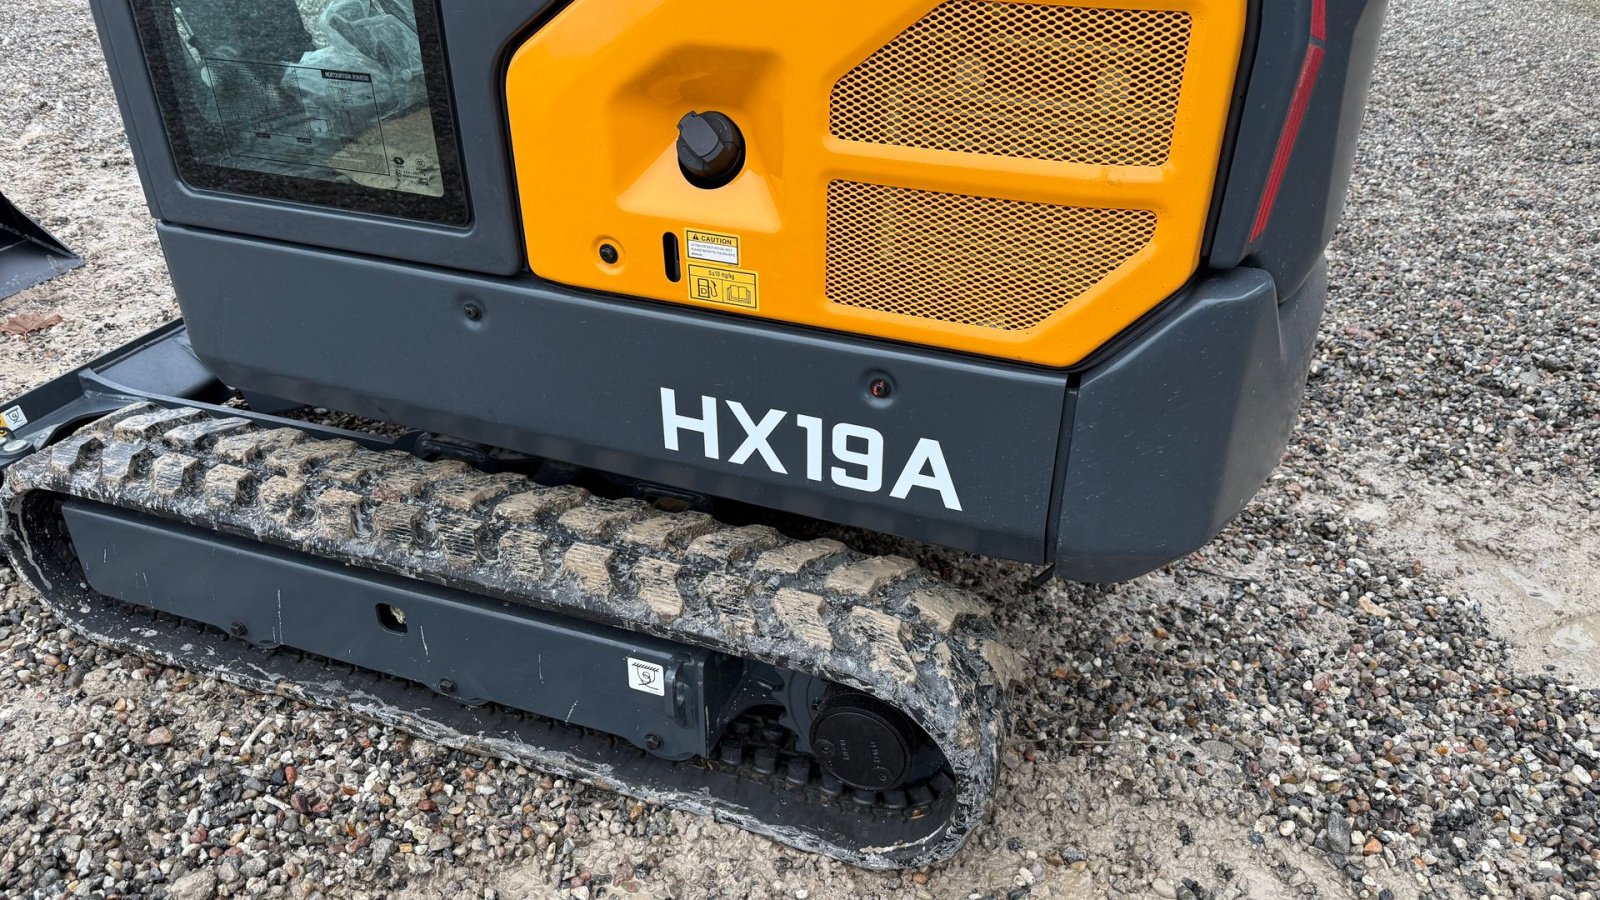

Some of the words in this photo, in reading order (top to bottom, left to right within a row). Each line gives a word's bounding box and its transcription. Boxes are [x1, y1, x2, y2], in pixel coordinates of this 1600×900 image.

[701, 235, 732, 246] CAUTION
[721, 272, 735, 281] mg/kg
[660, 387, 963, 512] HX19A
